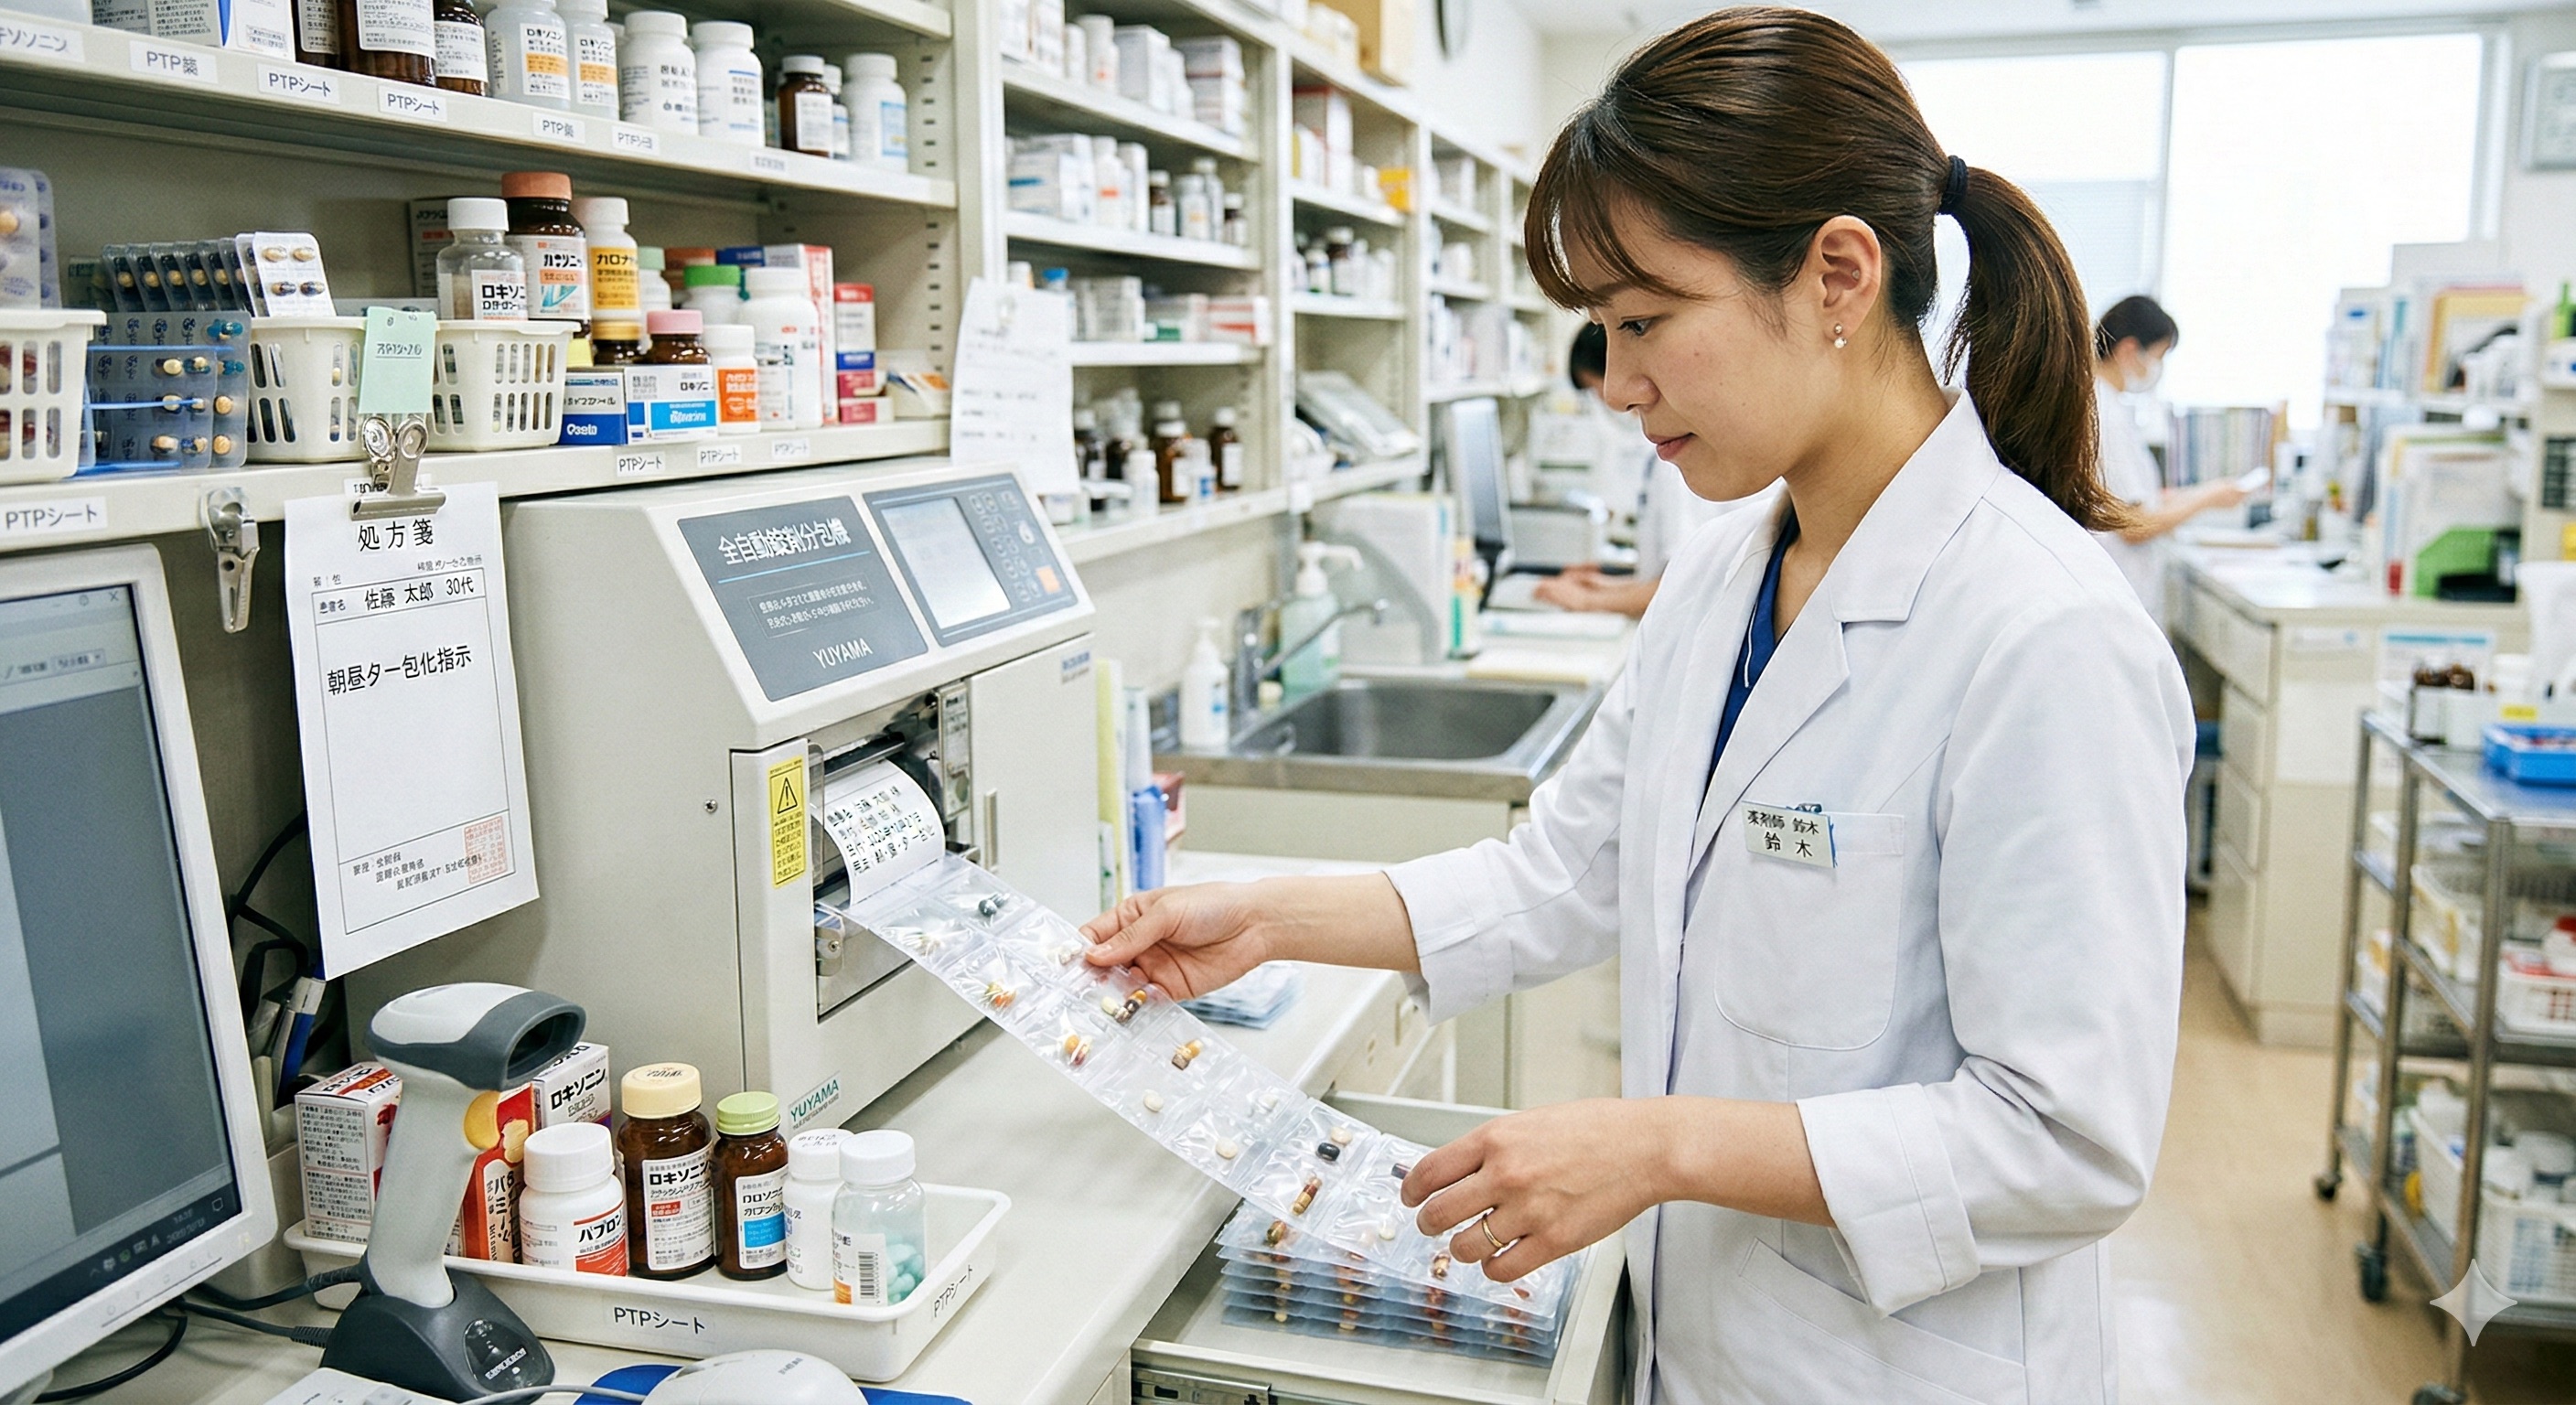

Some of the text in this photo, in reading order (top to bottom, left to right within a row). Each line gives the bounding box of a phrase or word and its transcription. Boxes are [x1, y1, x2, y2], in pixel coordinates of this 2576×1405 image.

[268, 72, 332, 97] PTPシート
[387, 93, 440, 115] PTPシート
[618, 456, 663, 472] PTPシート
[5, 504, 97, 530] PTPシート
[358, 518, 435, 552] 処方箋
[404, 582, 435, 604] 太郎
[445, 575, 475, 596] 30代
[812, 638, 874, 669] YUYAMA
[551, 1068, 606, 1110] ロキソニン
[790, 1079, 839, 1122] YUYAMA
[649, 1161, 711, 1185] ロキソニン
[579, 1209, 623, 1243] パブロン
[934, 1264, 972, 1318] PTPシート
[614, 1306, 705, 1335] PTPシート
